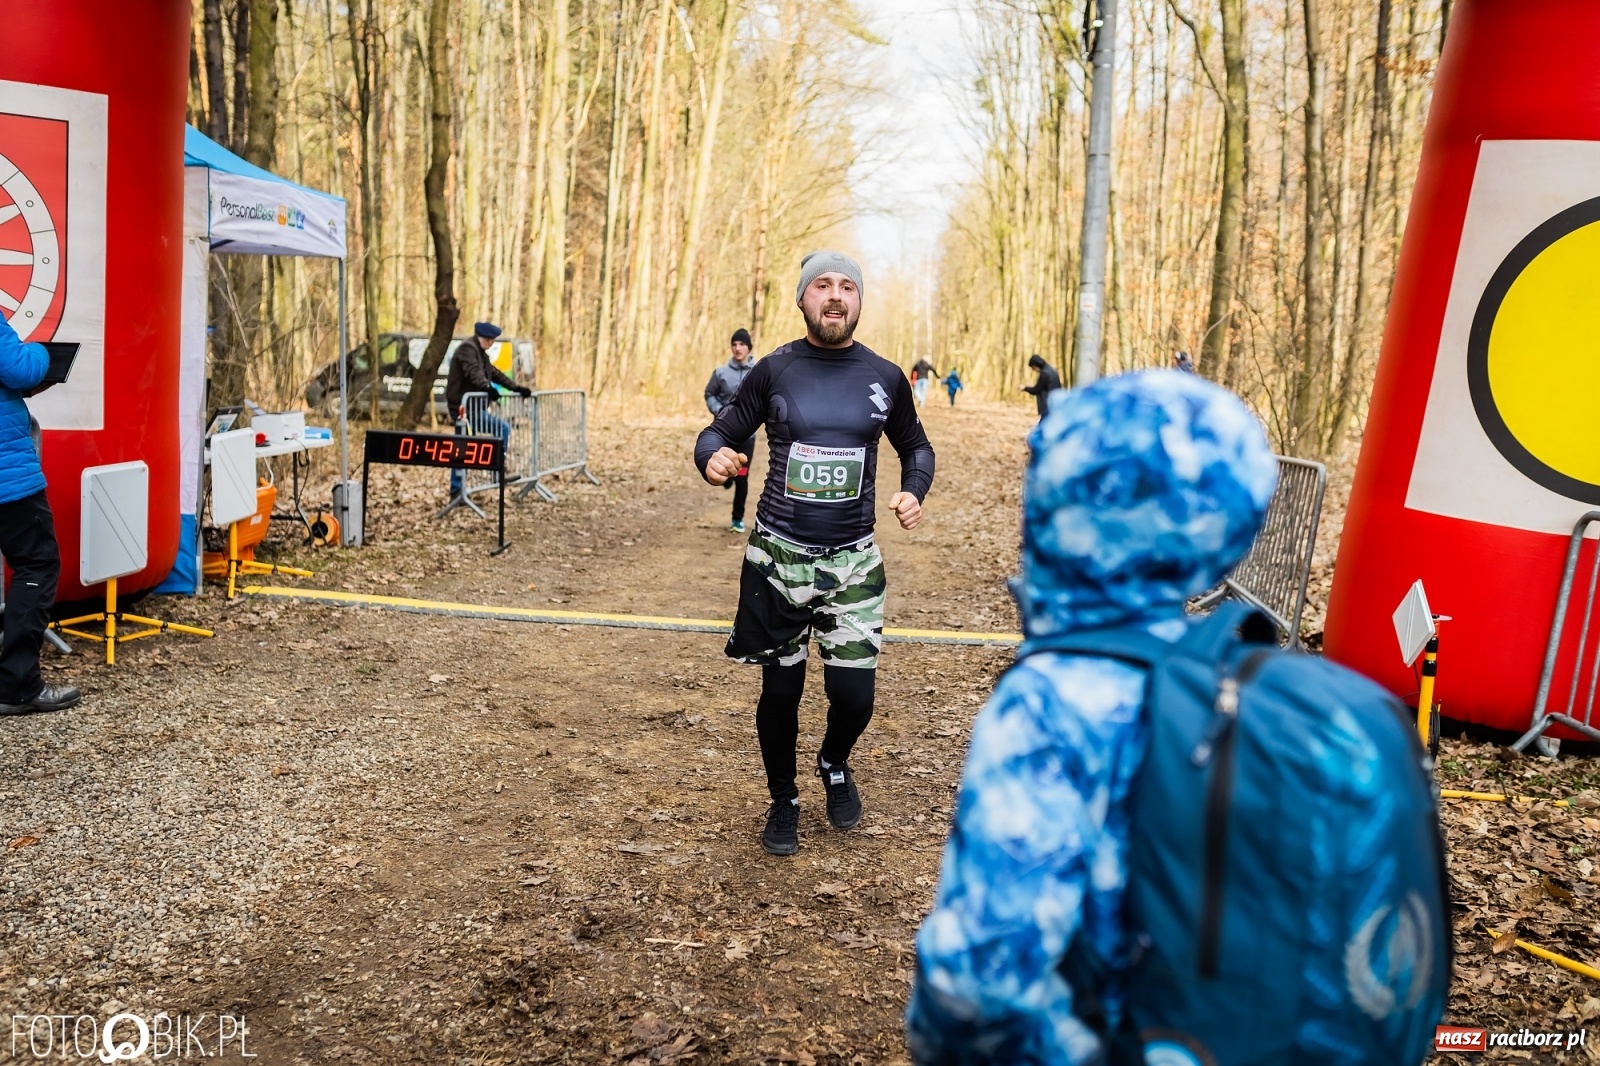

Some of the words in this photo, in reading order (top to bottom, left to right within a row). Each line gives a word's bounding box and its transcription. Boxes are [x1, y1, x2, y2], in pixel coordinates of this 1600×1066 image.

[220, 196, 275, 222] PersonalBest
[399, 438, 493, 465] 0:42:30
[802, 446, 815, 454] BIEG
[817, 449, 856, 457] Twardziela
[800, 463, 848, 486] 059
